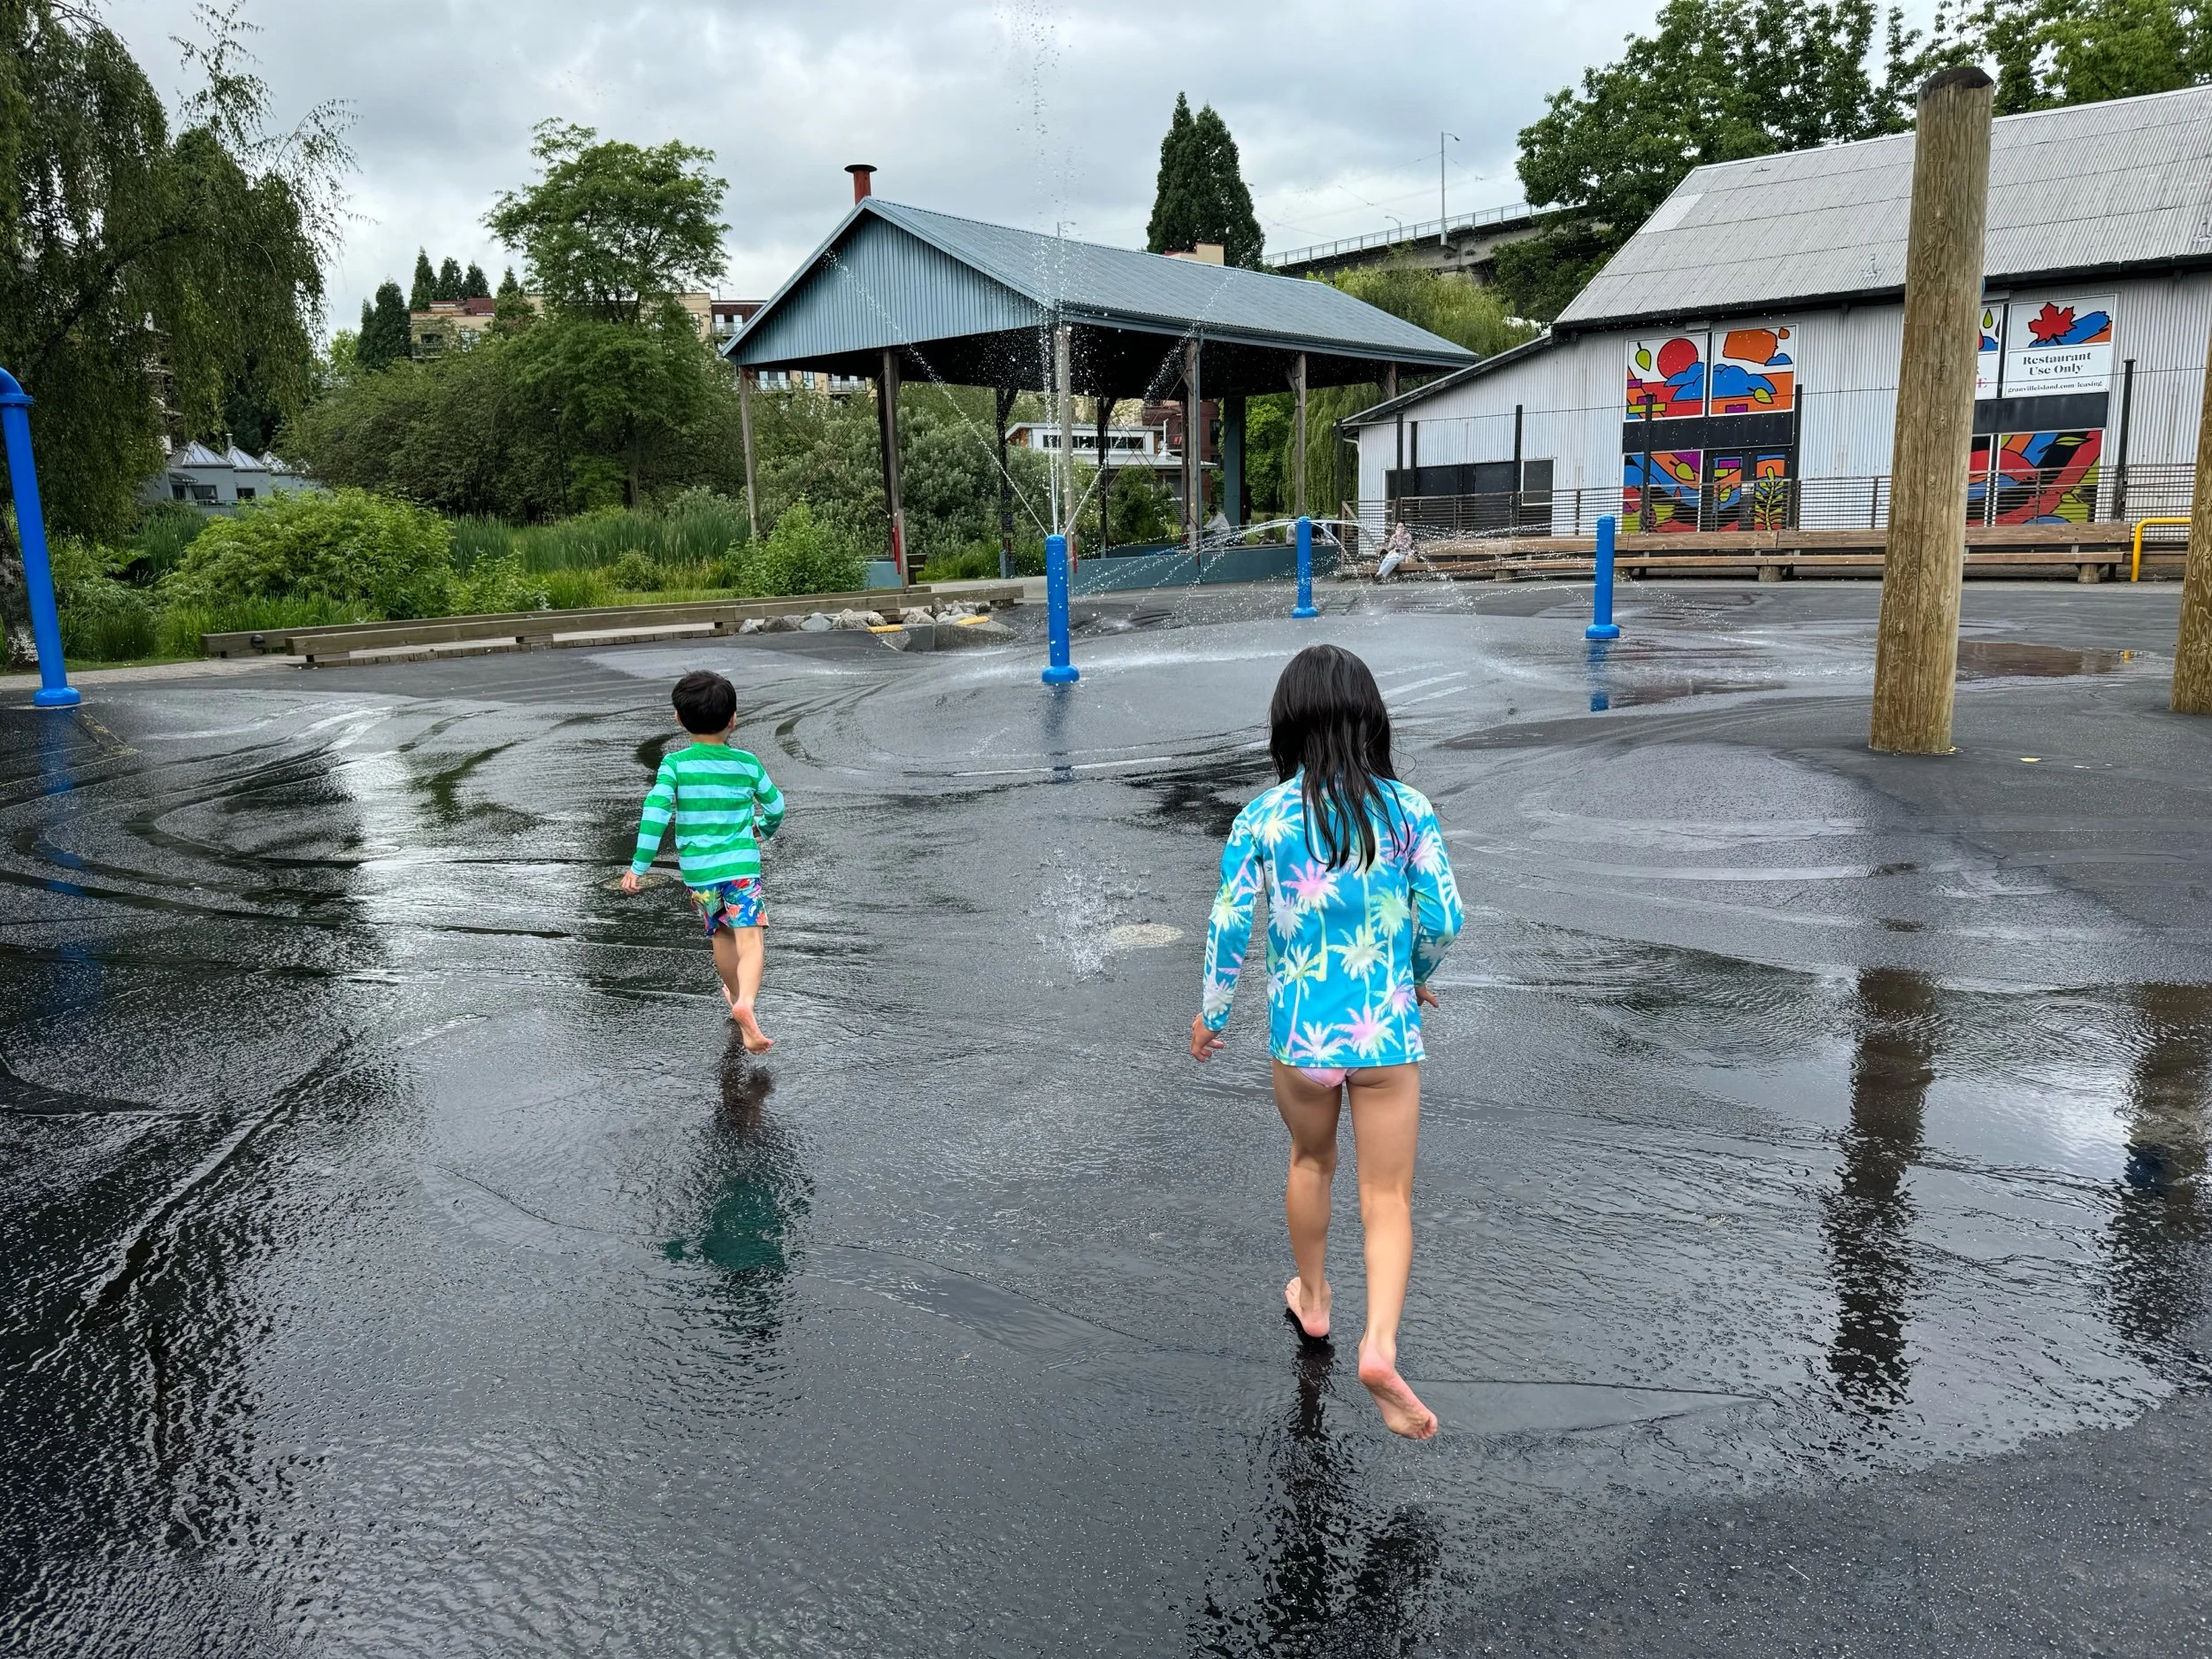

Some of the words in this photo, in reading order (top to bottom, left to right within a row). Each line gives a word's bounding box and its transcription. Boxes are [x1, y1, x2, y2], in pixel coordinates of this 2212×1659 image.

[2023, 352, 2091, 365] Restaurant
[2029, 366, 2051, 376] Use
[2054, 363, 2083, 373] Only
[2008, 380, 2102, 393] granvilleisland.comleasing
